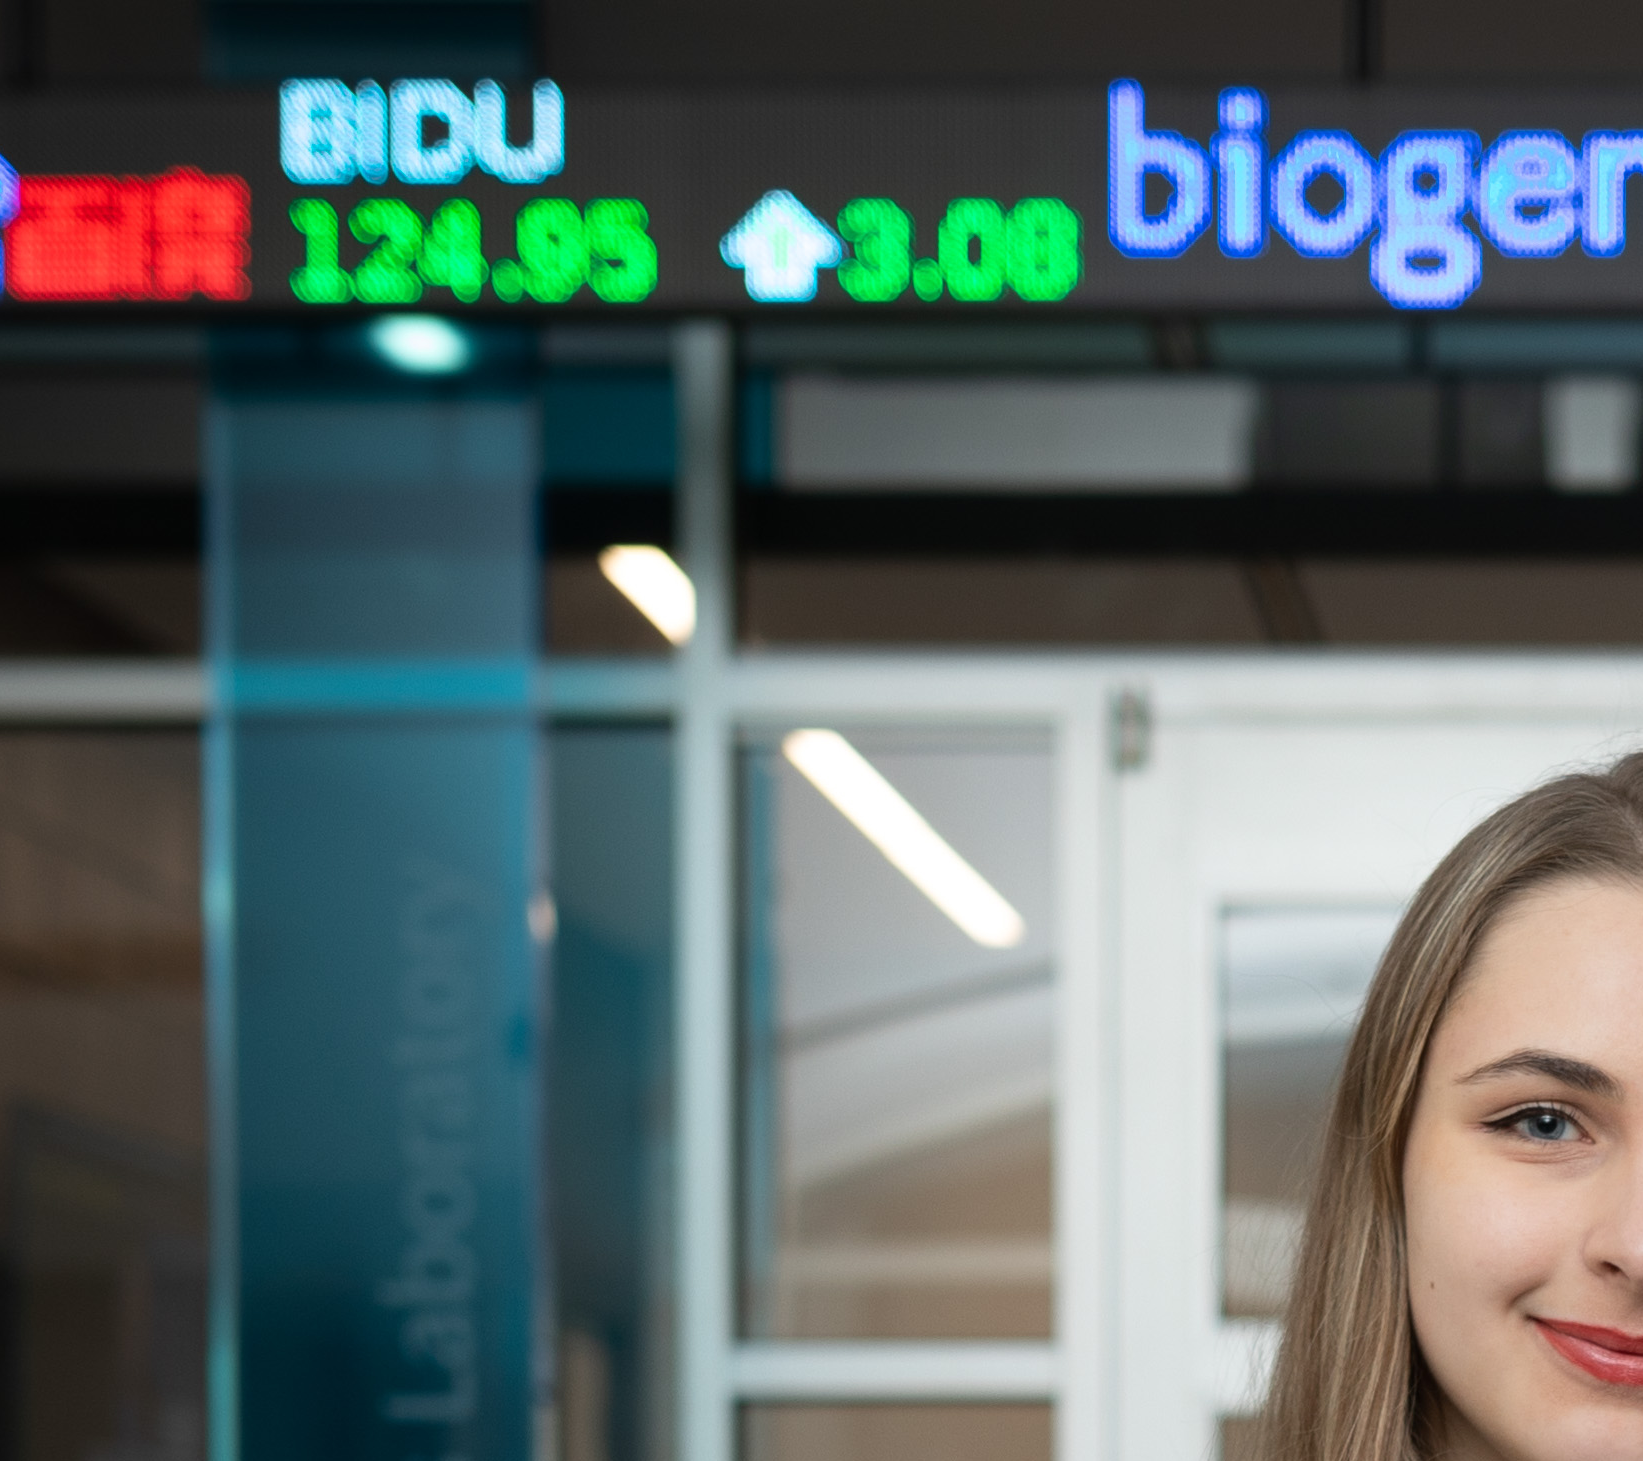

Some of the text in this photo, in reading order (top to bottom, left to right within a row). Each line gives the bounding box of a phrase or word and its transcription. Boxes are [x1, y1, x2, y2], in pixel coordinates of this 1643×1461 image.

[280, 78, 564, 184] BIDU
[289, 197, 1084, 304] 124.95 3.08
[379, 860, 495, 1420] Laboratory
